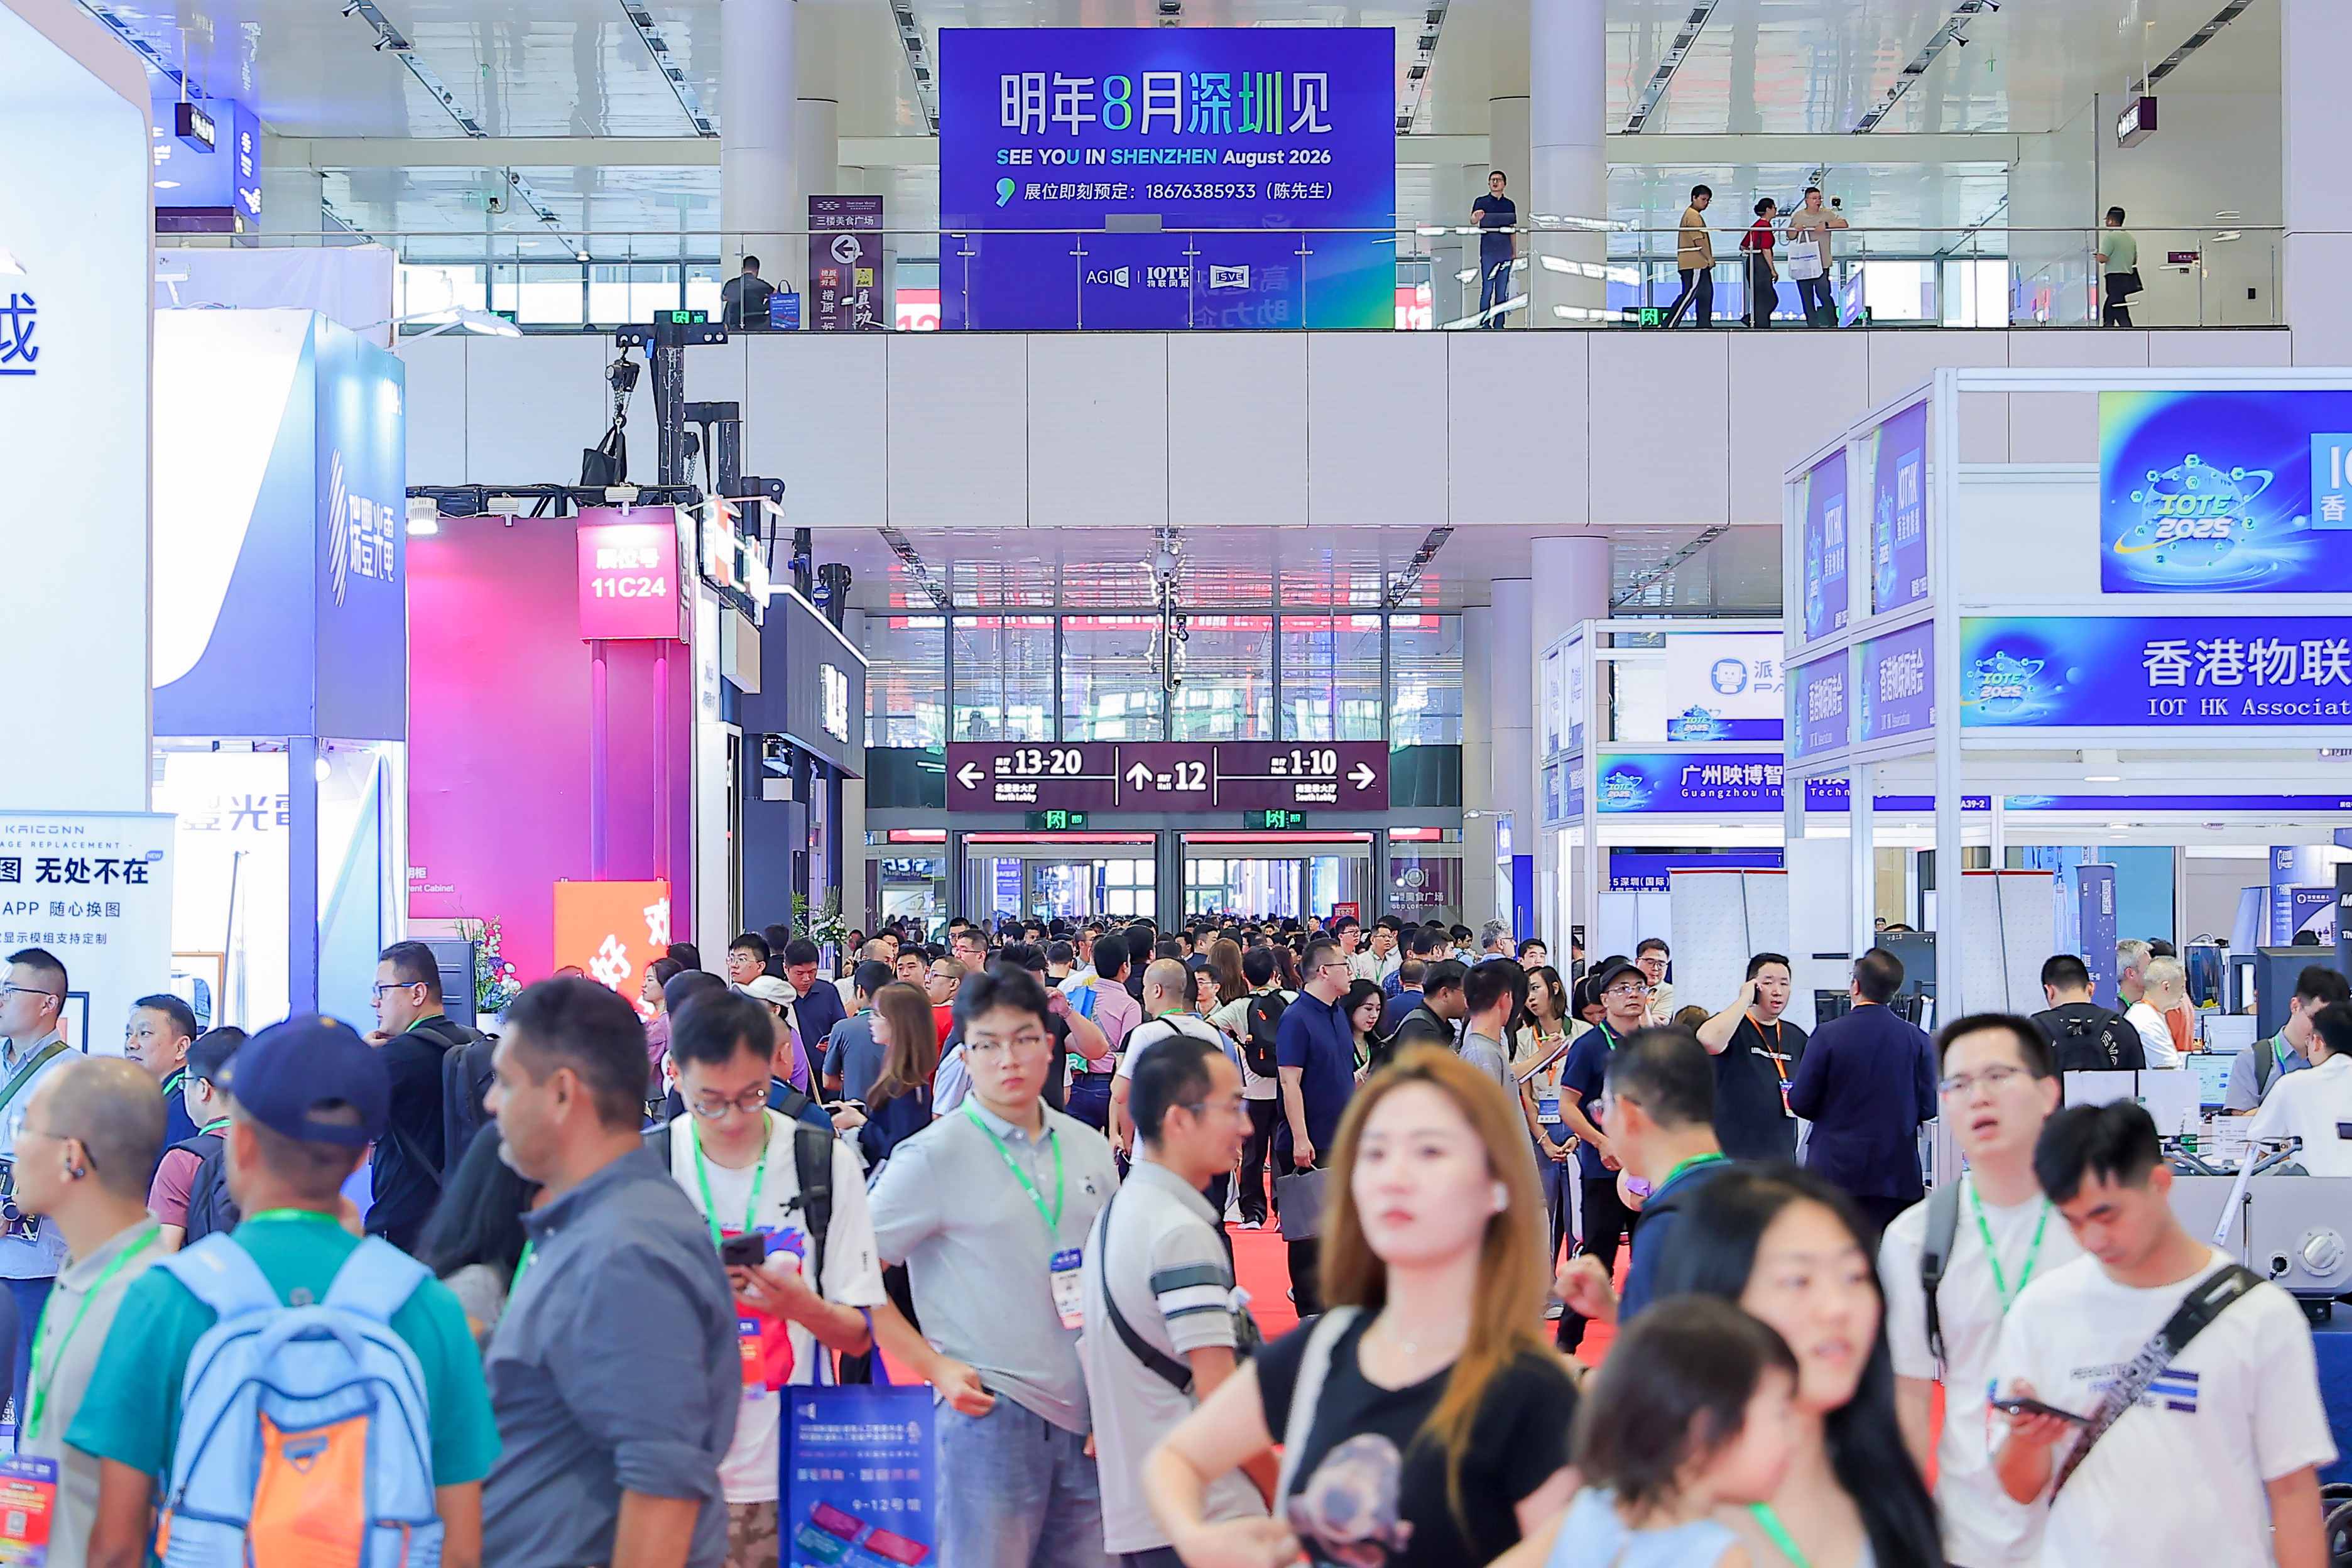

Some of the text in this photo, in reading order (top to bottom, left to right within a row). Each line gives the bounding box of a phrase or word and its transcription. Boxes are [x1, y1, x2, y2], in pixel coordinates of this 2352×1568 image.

[1000, 71, 1332, 136] 明年8月深圳见
[997, 149, 1331, 168] SEE YOU IN SHENZHEN August 2026
[2157, 493, 2231, 516] IOTE
[2154, 516, 2235, 539] 2025
[591, 577, 666, 597] 11C24
[2142, 638, 2351, 687] 香港物联
[1981, 672, 2022, 685] IOTE
[1979, 685, 2022, 698] 2025
[2147, 698, 2186, 716] IOT
[2200, 698, 2227, 716] HK
[1015, 749, 1082, 775] 13-20
[1290, 749, 1337, 775] 1-10
[1174, 761, 1207, 791] 12
[1680, 764, 1783, 787] 广州映博智
[1680, 788, 1758, 799] Guangzhou
[31, 841, 121, 849] REPLACEMENT
[35, 857, 149, 885] 无处不在
[423, 884, 454, 892] Cabinet
[3, 901, 121, 917] APP 随心换图
